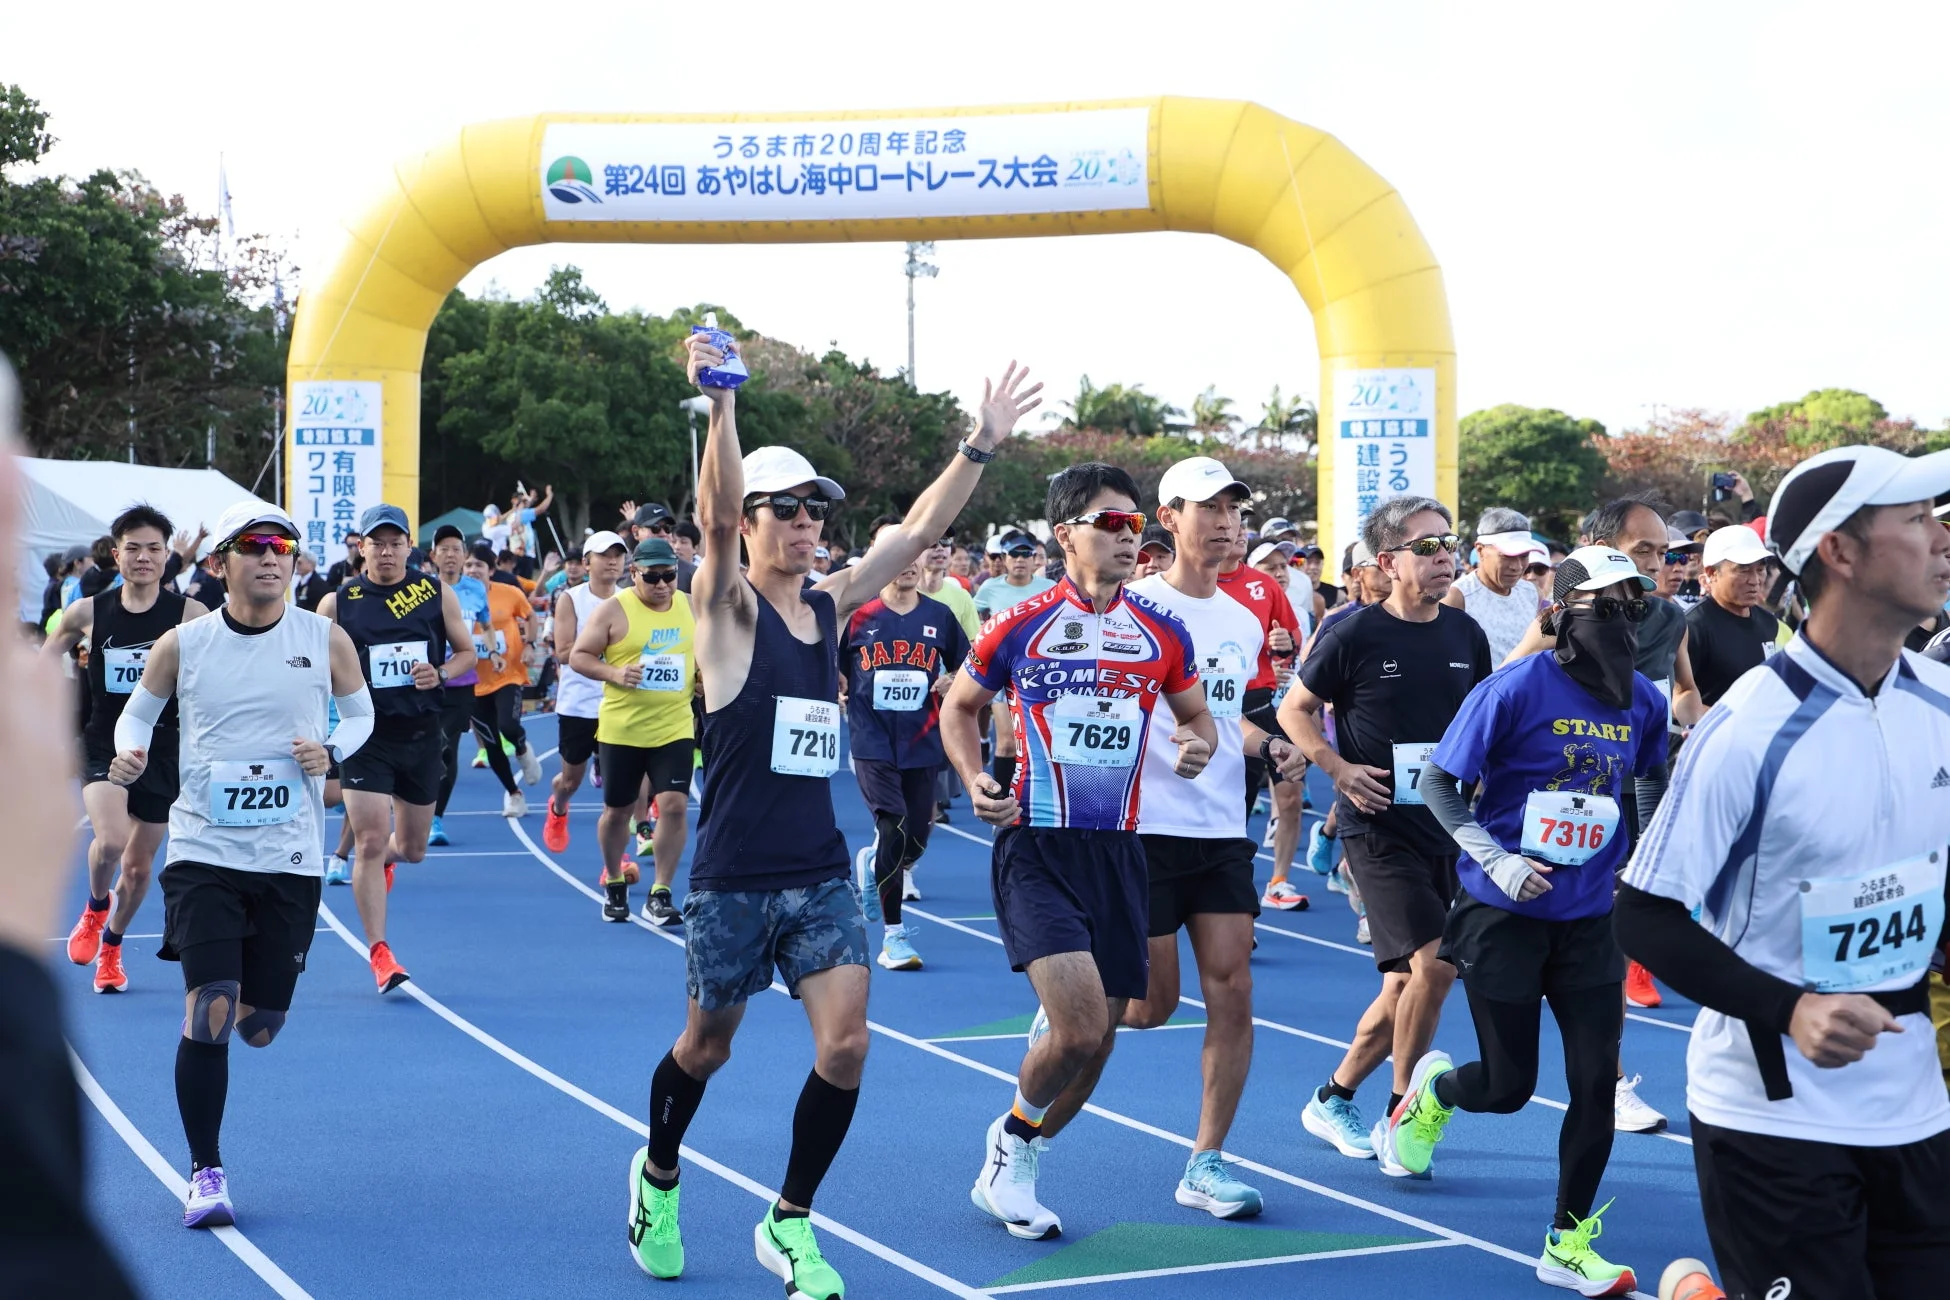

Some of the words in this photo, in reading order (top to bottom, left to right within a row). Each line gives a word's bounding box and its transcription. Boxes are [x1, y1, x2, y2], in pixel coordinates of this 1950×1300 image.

[713, 129, 966, 159] うるま市20周年記念
[603, 164, 686, 196] 第24回
[697, 154, 1058, 196] あやはし海中ロードレース大会
[301, 394, 328, 415] 20
[332, 450, 356, 545] 有限会社
[1357, 443, 1380, 538] 建設業
[385, 578, 435, 614] HUM
[646, 668, 679, 682] 7263
[1016, 662, 1060, 676] TEAM
[1020, 668, 1162, 694] KOMESU
[882, 686, 920, 701] 7507
[1047, 686, 1141, 699] OKINAWA
[1068, 722, 1131, 750] 7629
[1552, 718, 1632, 742] START
[790, 728, 836, 760] 7218
[224, 785, 290, 810] 7220
[1540, 817, 1605, 849] 7316
[1853, 884, 1905, 909] 建設業者会
[1860, 873, 1898, 894] うるま市
[1829, 903, 1926, 963] 7244
